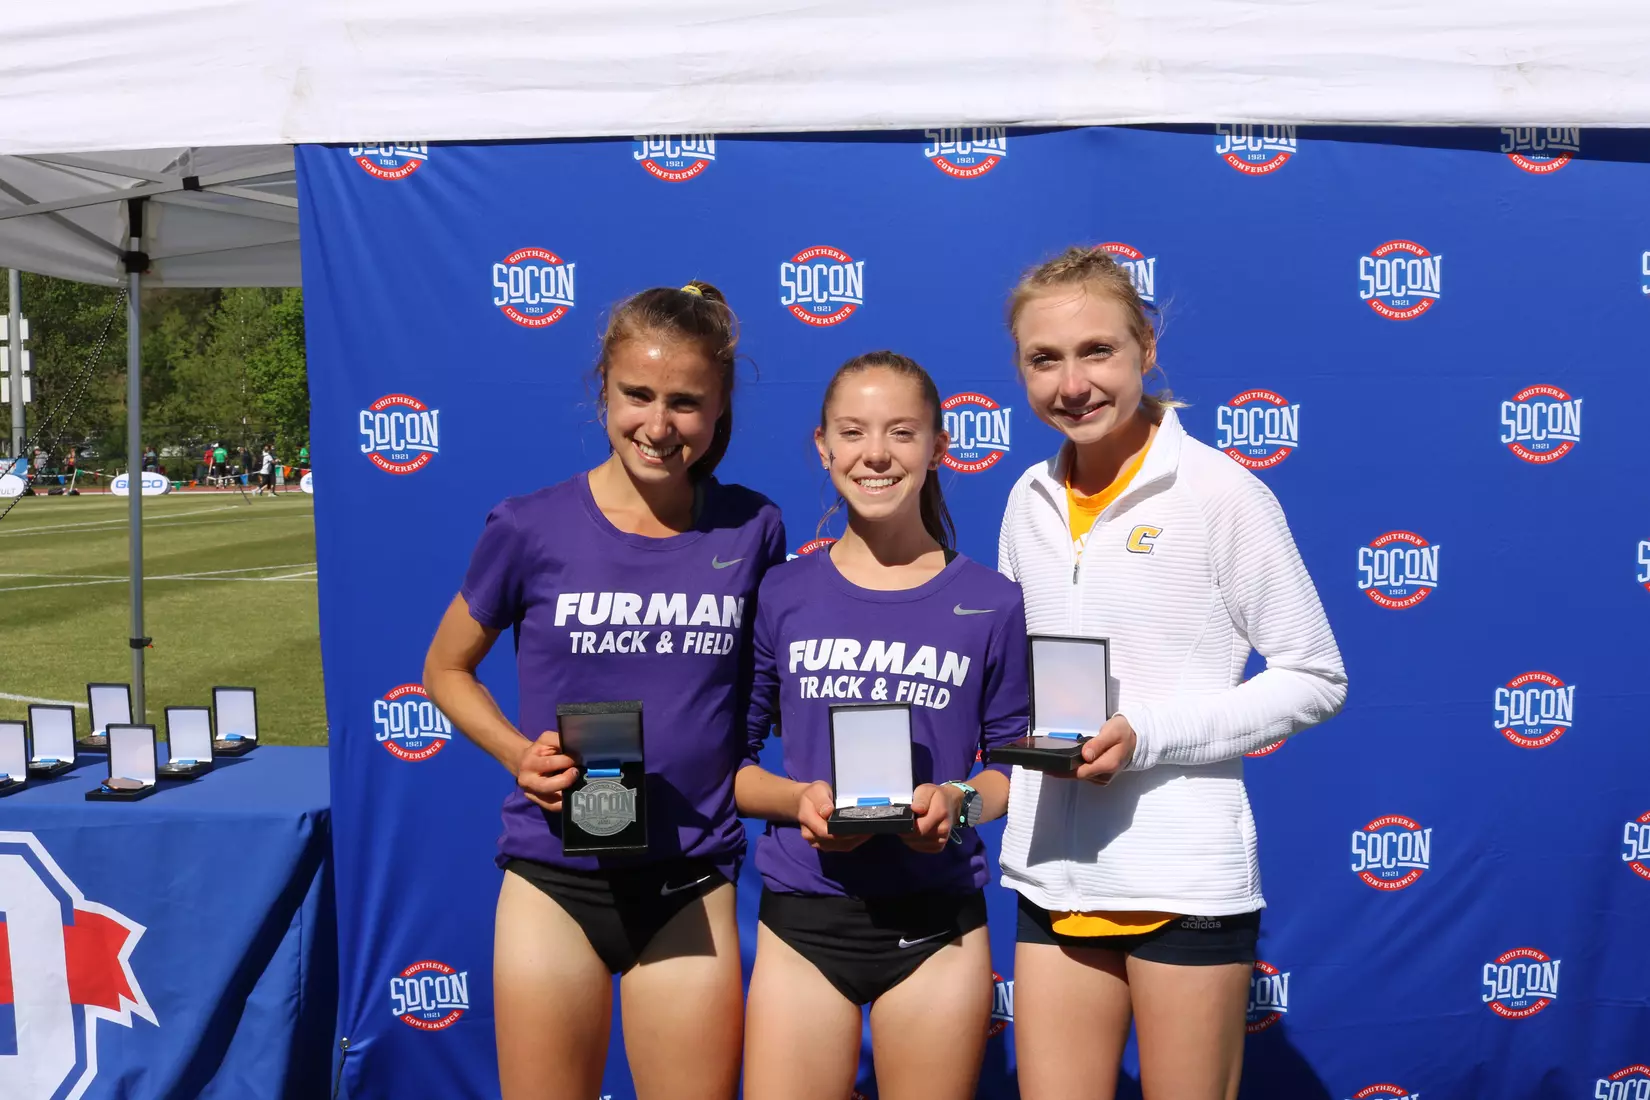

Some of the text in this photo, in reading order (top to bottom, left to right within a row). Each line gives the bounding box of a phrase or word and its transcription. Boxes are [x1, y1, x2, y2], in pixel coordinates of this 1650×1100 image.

[360, 158, 417, 178] CONFERENCE
[645, 161, 703, 179] CONFERENCE
[937, 158, 995, 176] CONFERENCE
[1228, 154, 1285, 173] CONFERENCE
[1512, 154, 1569, 172] CONFERENCE
[509, 251, 557, 263] SOUTHERN
[797, 249, 846, 262] SOUTHERN
[1103, 244, 1137, 258] THERN
[1376, 243, 1423, 256] SOUTHERN
[493, 263, 575, 306] SOCON
[781, 261, 864, 305] SOCON
[1360, 255, 1442, 299] SOCON
[506, 307, 563, 325] CONFERENCE
[794, 306, 851, 324] CONFERENCE
[1372, 300, 1429, 318] CONFERENCE
[375, 397, 421, 410] SOUTHERN
[945, 396, 993, 409] SOUTHERN
[1234, 392, 1281, 405] SOUTHERN
[1518, 388, 1564, 401] SOUTHERN
[943, 408, 1011, 451] OCON
[1217, 404, 1300, 448] SOCON
[1501, 399, 1582, 443] SOCON
[360, 410, 439, 453] SOCON
[1230, 449, 1286, 467] CONFERENCE
[1513, 444, 1568, 461] CONFERENCE
[373, 454, 428, 472] CONFERENCE
[116, 479, 163, 489] GCO
[1126, 525, 1163, 554] C
[1375, 534, 1422, 546] SOUTHERN
[1358, 545, 1440, 589] SOCON
[1370, 590, 1426, 608] CONFERENCE
[554, 592, 744, 628] FURMAN
[570, 631, 734, 655] TRACK & FIELD
[789, 638, 971, 687] FURMAN
[1512, 675, 1557, 687] SOUTHERN
[389, 686, 427, 699] SOUTHER
[800, 676, 951, 710] TRACK & FIELD
[1494, 686, 1576, 728] SOCON
[1506, 730, 1560, 747] CONFERENCE
[388, 743, 441, 759] CONFERENCE
[1369, 817, 1415, 830] SOUTHERN
[1351, 828, 1432, 872] SOCON
[1363, 871, 1418, 888] CONFERENCE
[1181, 919, 1221, 930] adidas
[1500, 949, 1544, 963] SOUTHERN
[405, 963, 450, 976] SOUTHERN
[1482, 960, 1561, 1002] SOCON
[390, 971, 469, 1016] SOCON
[1492, 1000, 1546, 1018] CONFERENCE
[405, 1010, 459, 1028] CONFERENCE
[1359, 1085, 1402, 1098] SOUTHERN
